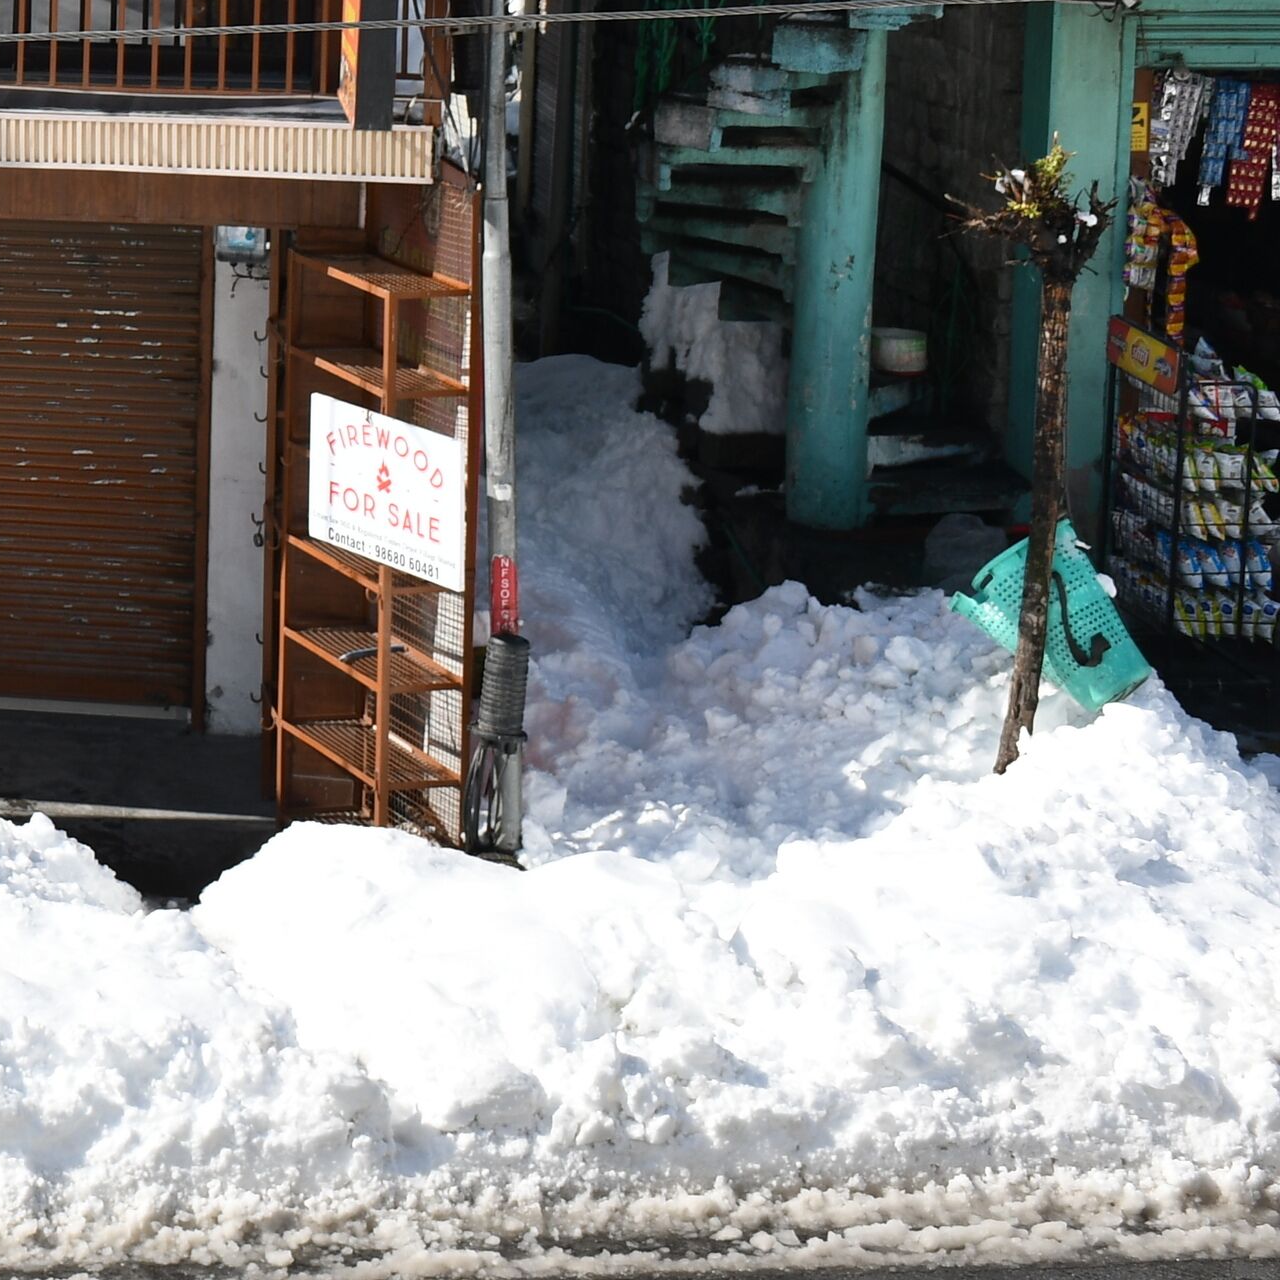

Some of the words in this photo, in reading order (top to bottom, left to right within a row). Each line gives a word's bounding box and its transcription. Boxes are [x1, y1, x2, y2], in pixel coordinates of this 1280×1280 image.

[326, 424, 444, 489] FIREWOOD
[329, 480, 376, 520] FOR
[388, 503, 442, 545] SALE
[328, 527, 366, 553] Contact
[375, 545, 406, 567] 98680
[409, 558, 440, 580] 60481
